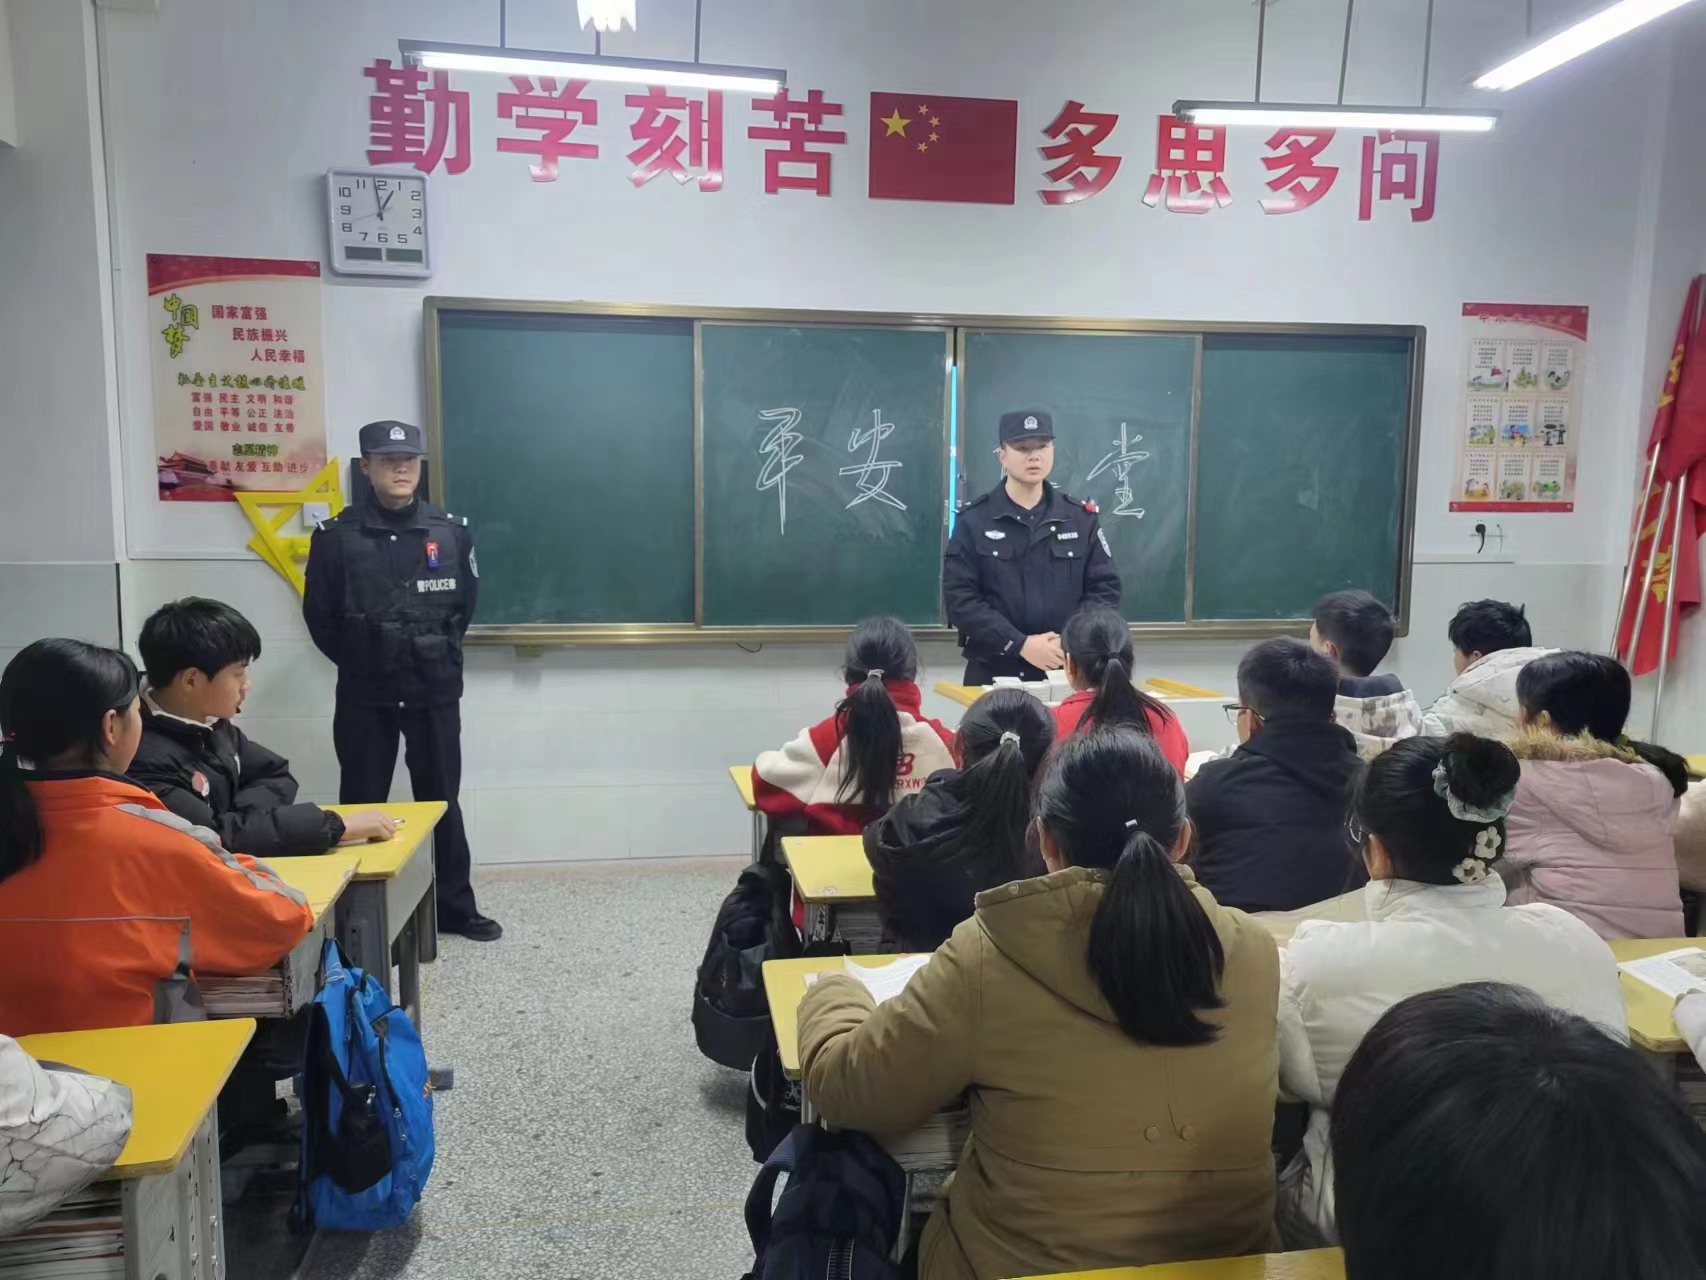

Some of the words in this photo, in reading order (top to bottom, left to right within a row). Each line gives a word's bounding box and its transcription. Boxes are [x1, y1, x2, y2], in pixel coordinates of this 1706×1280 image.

[364, 59, 847, 197] 勤学刻苦
[1038, 100, 1439, 222] 多思多问
[356, 178, 366, 189] 11
[338, 187, 351, 198] 10
[411, 190, 421, 201] 2
[341, 205, 351, 215] 9
[412, 208, 422, 218] 3
[342, 222, 352, 232] 8
[413, 226, 422, 235] 4
[359, 232, 368, 241] 7
[377, 232, 388, 243] 6
[397, 234, 408, 243] 5
[211, 304, 268, 321] 国家富强
[162, 293, 199, 359] 中国梦
[232, 327, 288, 343] 民族振兴
[250, 348, 306, 364] 人民幸福
[191, 392, 213, 404] 富强
[219, 392, 240, 405] 民主
[246, 393, 267, 405] 文明
[273, 394, 294, 406] 和谐
[192, 406, 213, 417] 自由
[219, 407, 240, 419] 平等
[246, 408, 267, 420] 公正
[273, 409, 294, 419] 法治
[192, 420, 214, 432] 爱国
[219, 421, 241, 432] 敬业
[247, 422, 268, 433] 诚信
[261, 461, 284, 474] 互助
